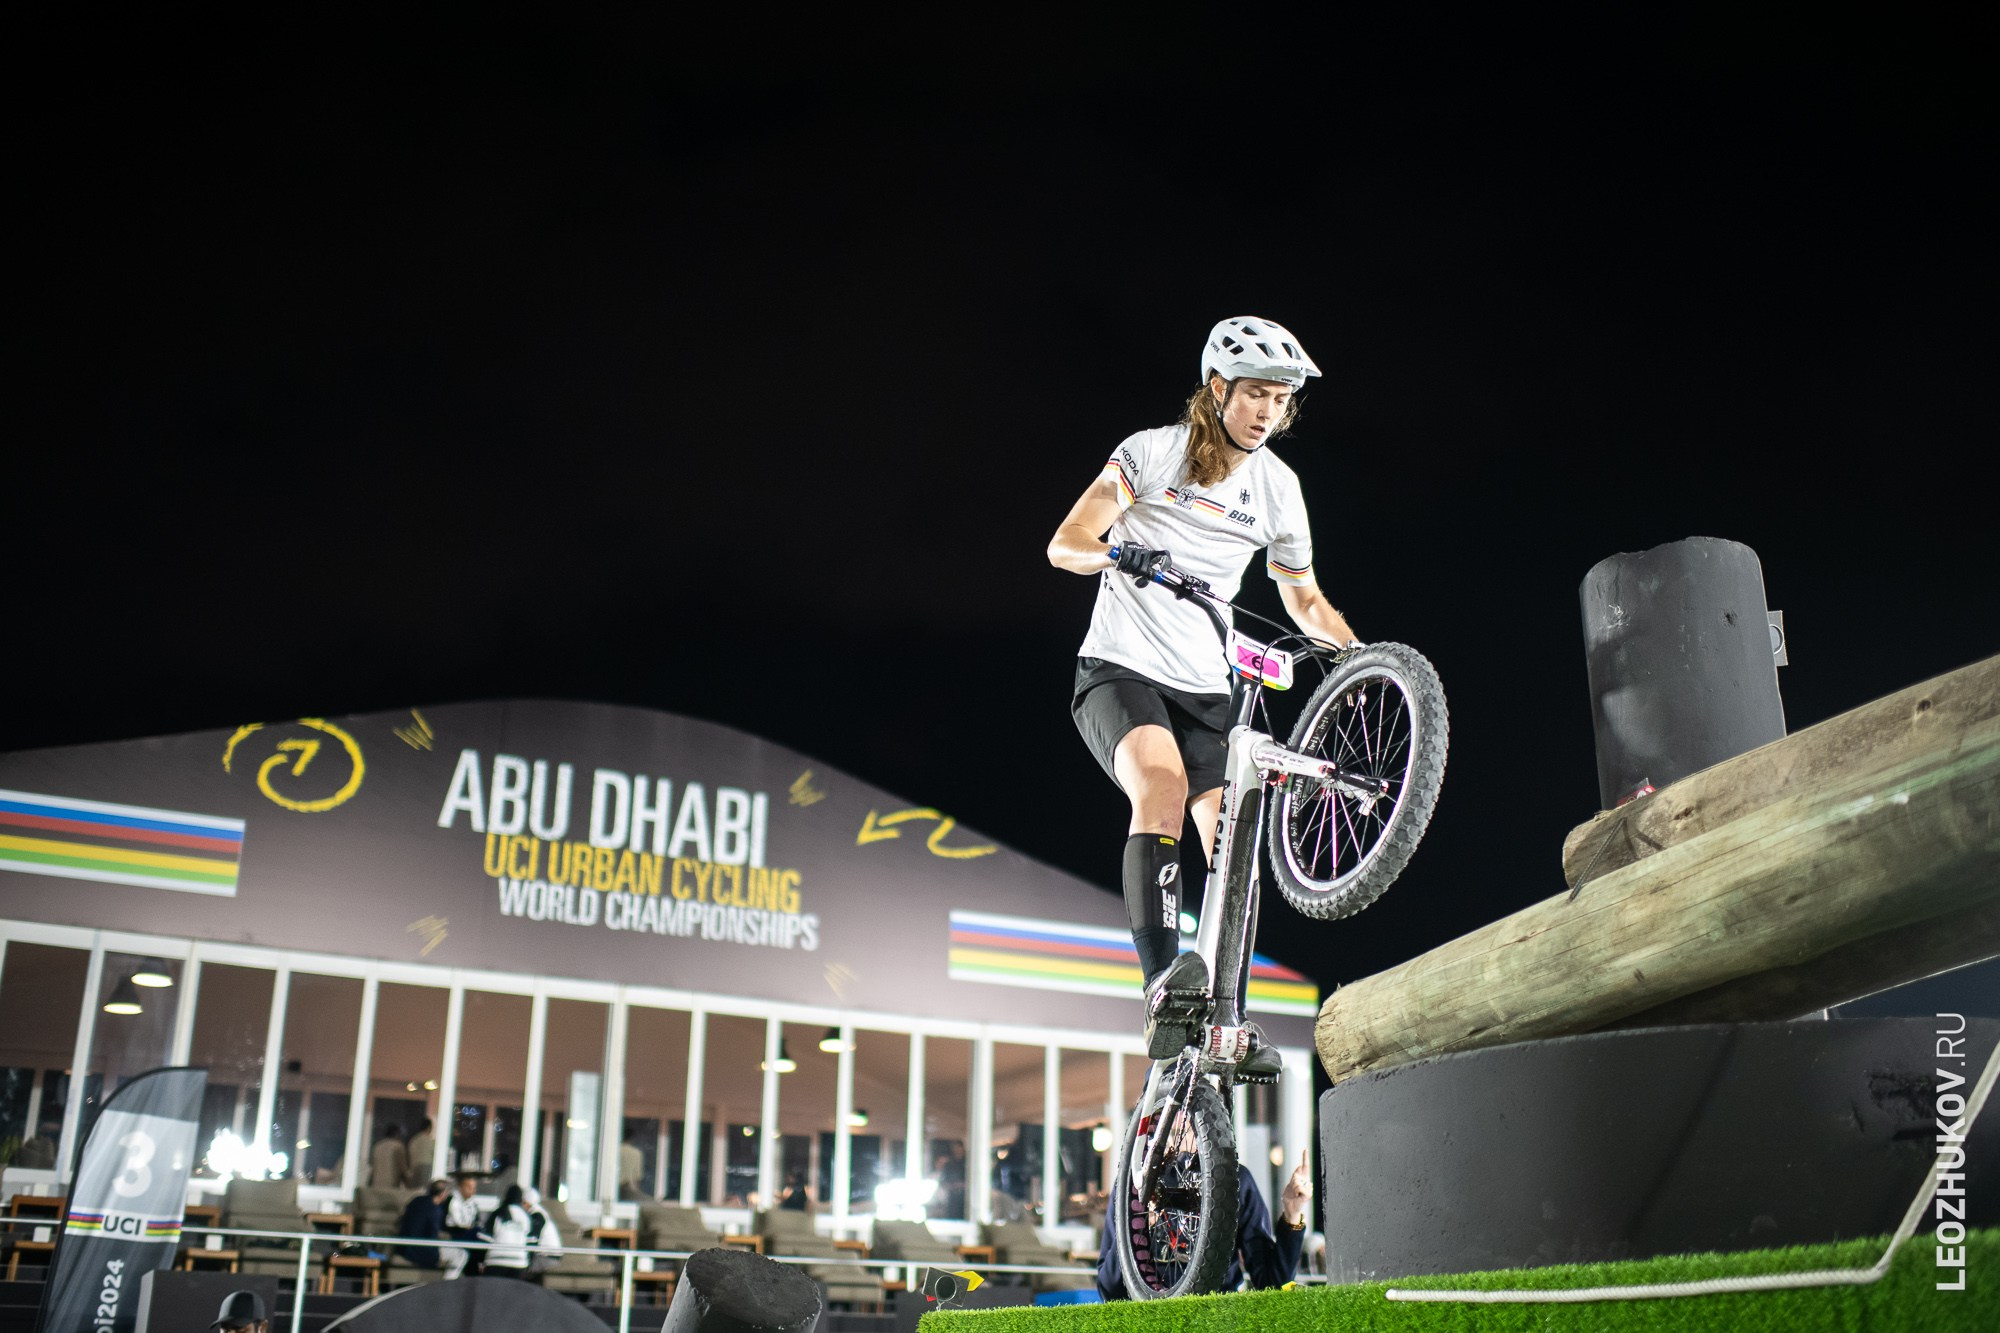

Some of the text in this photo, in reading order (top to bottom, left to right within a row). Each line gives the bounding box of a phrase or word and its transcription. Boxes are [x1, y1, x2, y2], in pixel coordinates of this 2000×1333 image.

[1228, 510, 1256, 526] BDR
[437, 748, 770, 868] ABU DHABI
[483, 833, 801, 915] UCI URBAN CYCLING
[498, 877, 819, 953] WORLD CHAMPIONSHIPS
[112, 1130, 156, 1198] 3
[103, 1214, 142, 1236] UCI
